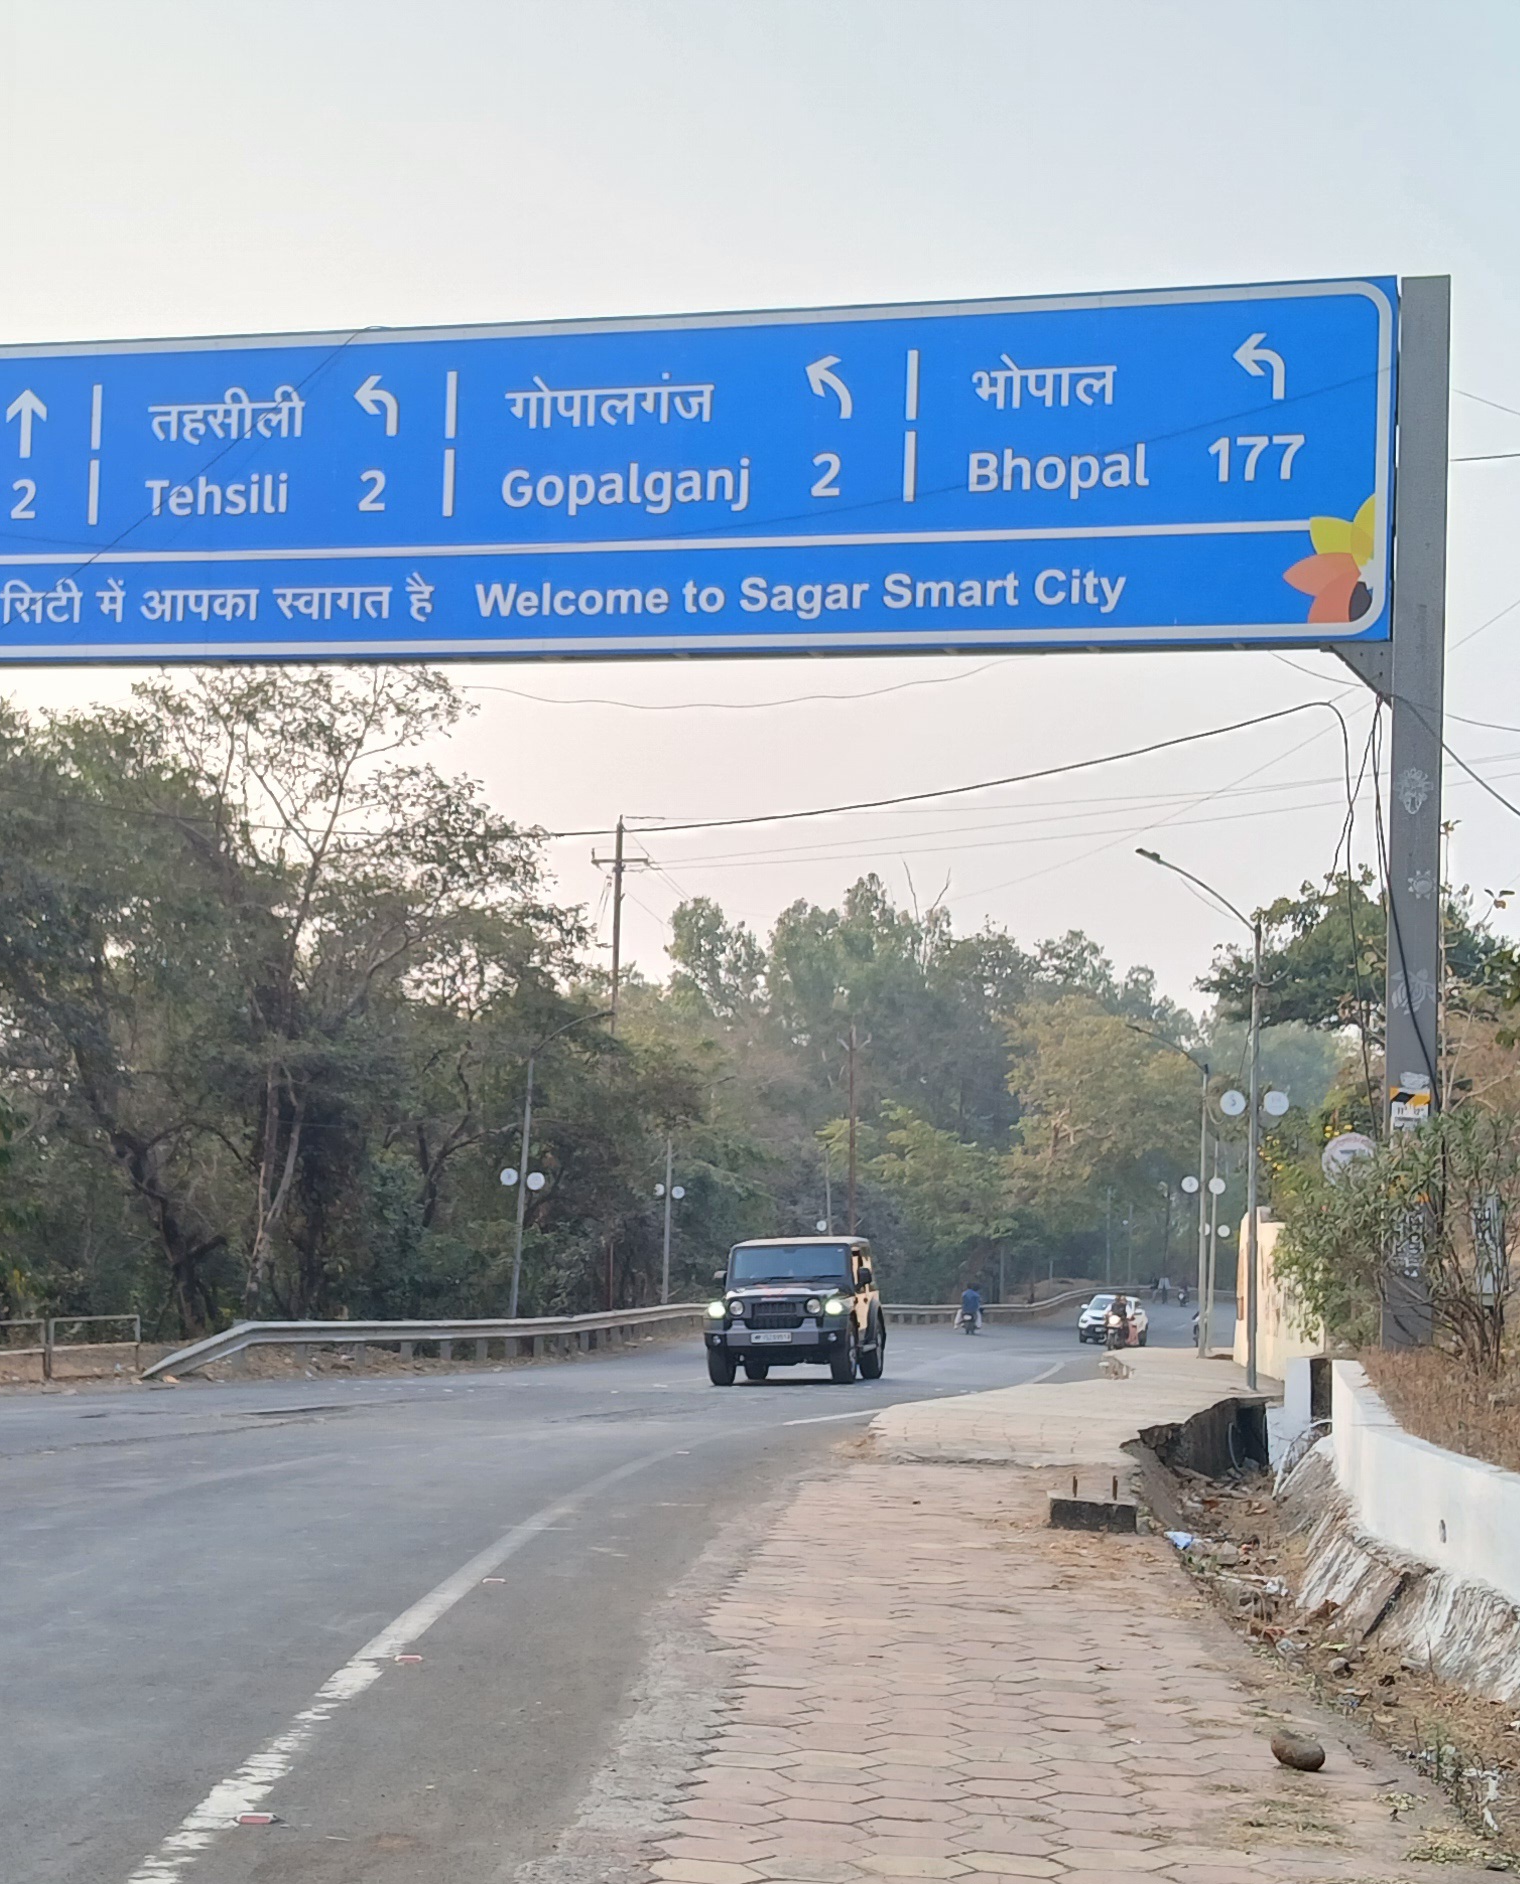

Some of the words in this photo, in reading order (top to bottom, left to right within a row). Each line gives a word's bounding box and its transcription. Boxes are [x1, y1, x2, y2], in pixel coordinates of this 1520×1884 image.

[505, 372, 715, 429] गोपालगंज
[972, 353, 1117, 409] भोपाल
[149, 385, 306, 445] तहसीली
[145, 472, 288, 516] Tehsili
[358, 469, 386, 511] 2
[502, 457, 750, 516] Gopalganj
[811, 453, 841, 497] 2
[969, 443, 1149, 500] Bhopal
[1209, 434, 1305, 482] 177
[10, 478, 37, 519] 2
[0, 578, 83, 624] सिटी
[95, 578, 126, 623] में
[140, 588, 260, 622] आपका
[273, 586, 393, 620] स्वागत
[406, 572, 435, 622] है
[475, 582, 669, 617] Welcome
[683, 580, 725, 613] to
[739, 576, 870, 620] Sagar
[883, 572, 1019, 609] Smart
[1034, 569, 1126, 613] City
